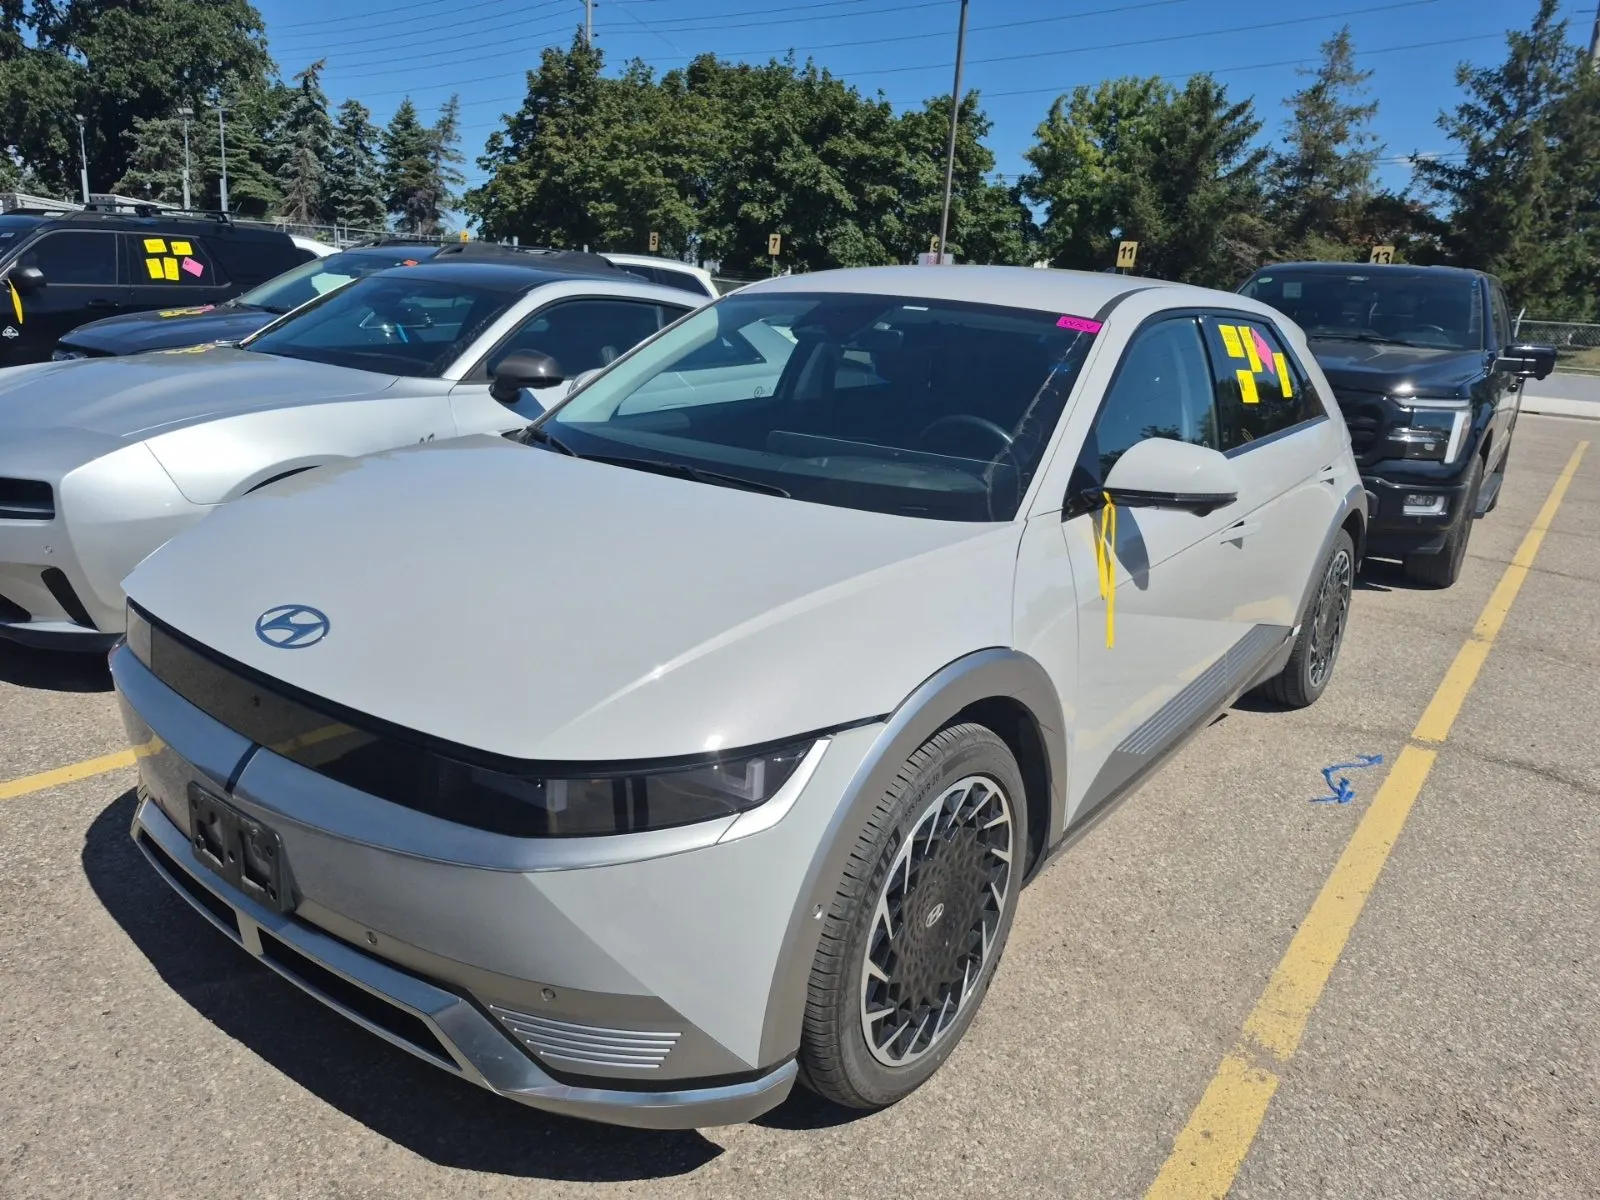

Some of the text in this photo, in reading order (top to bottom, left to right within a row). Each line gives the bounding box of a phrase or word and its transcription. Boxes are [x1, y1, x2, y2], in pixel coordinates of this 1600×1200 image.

[771, 237, 778, 249] 7
[1120, 246, 1134, 260] 11
[1373, 251, 1391, 264] 13
